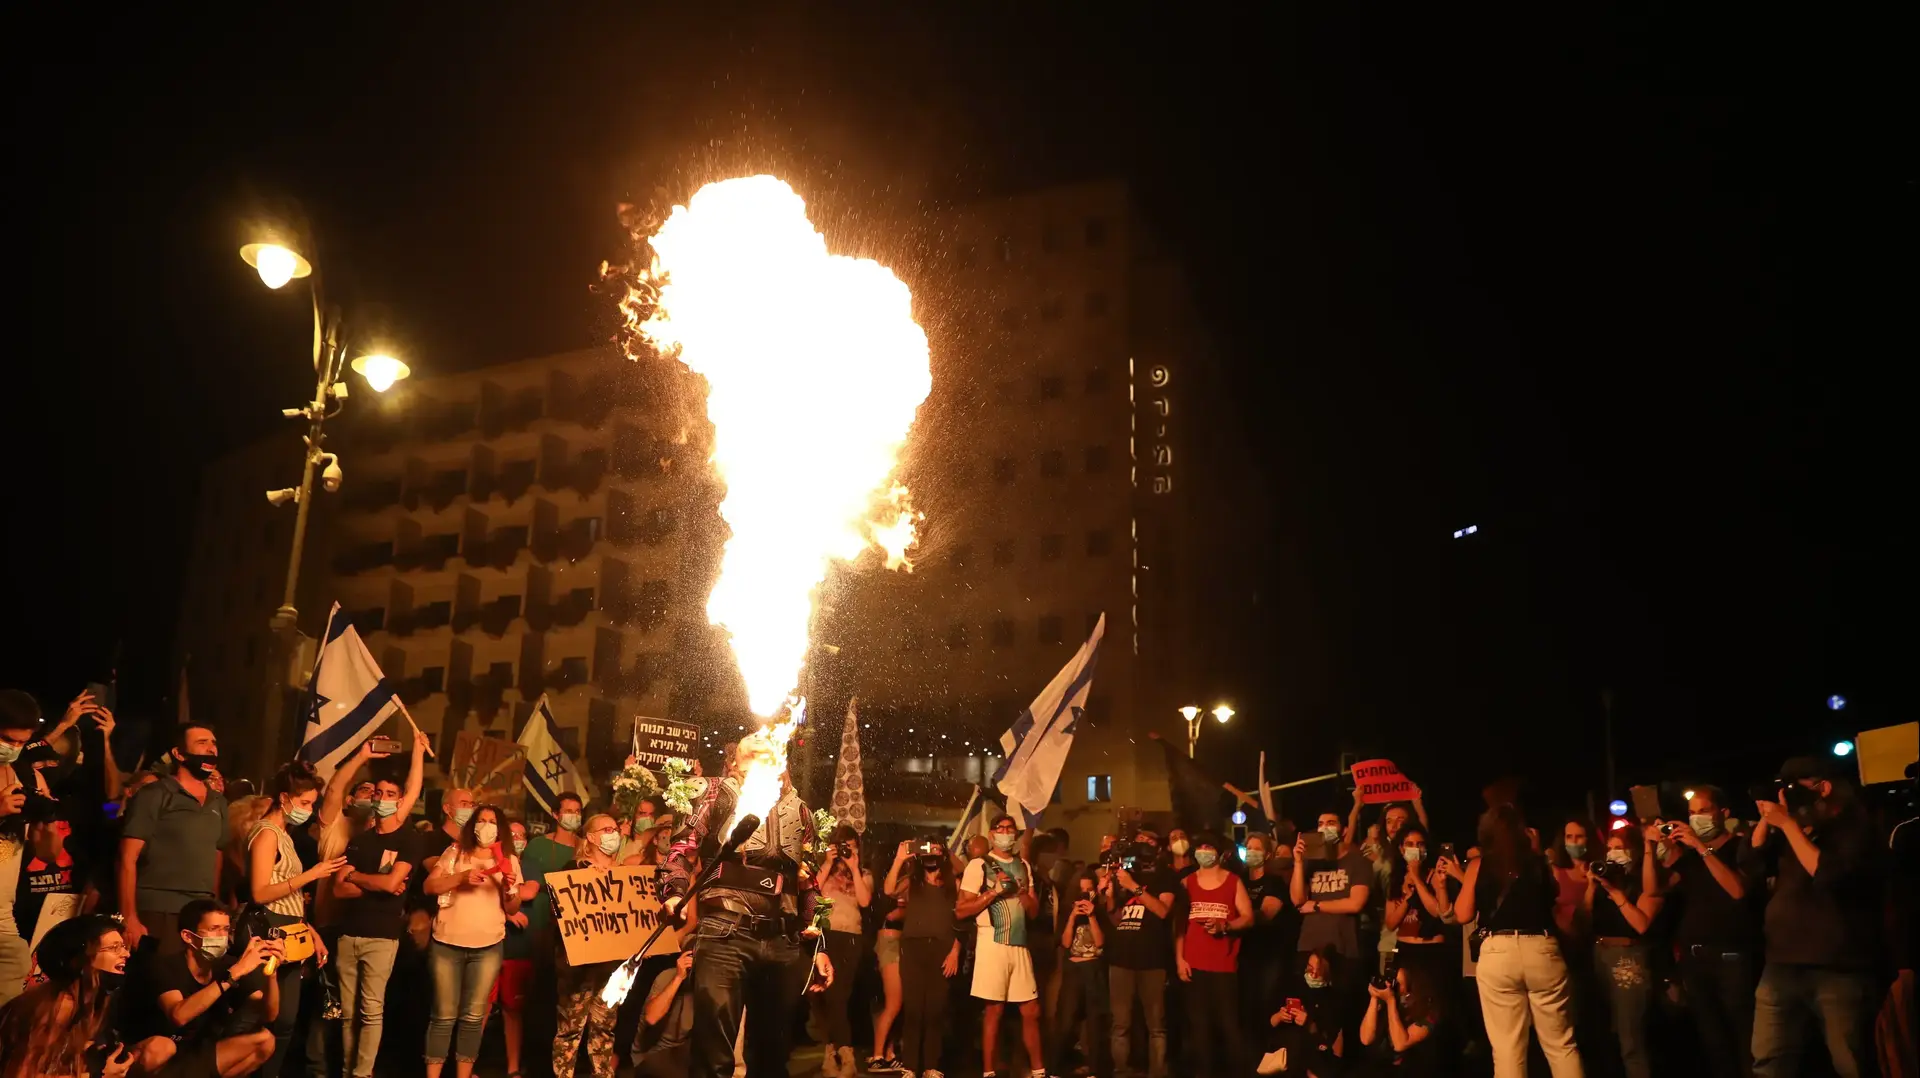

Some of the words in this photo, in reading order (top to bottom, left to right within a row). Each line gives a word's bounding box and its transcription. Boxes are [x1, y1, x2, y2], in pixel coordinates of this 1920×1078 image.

[1151, 365, 1172, 494] פרימה
[640, 723, 665, 735] תנוח
[666, 726, 681, 738] שב
[650, 738, 674, 751] תירא
[675, 740, 688, 753] אל
[1311, 869, 1348, 882] STAR
[595, 870, 624, 903] לא
[1311, 880, 1348, 893] WARS
[1121, 905, 1145, 920] מצ
